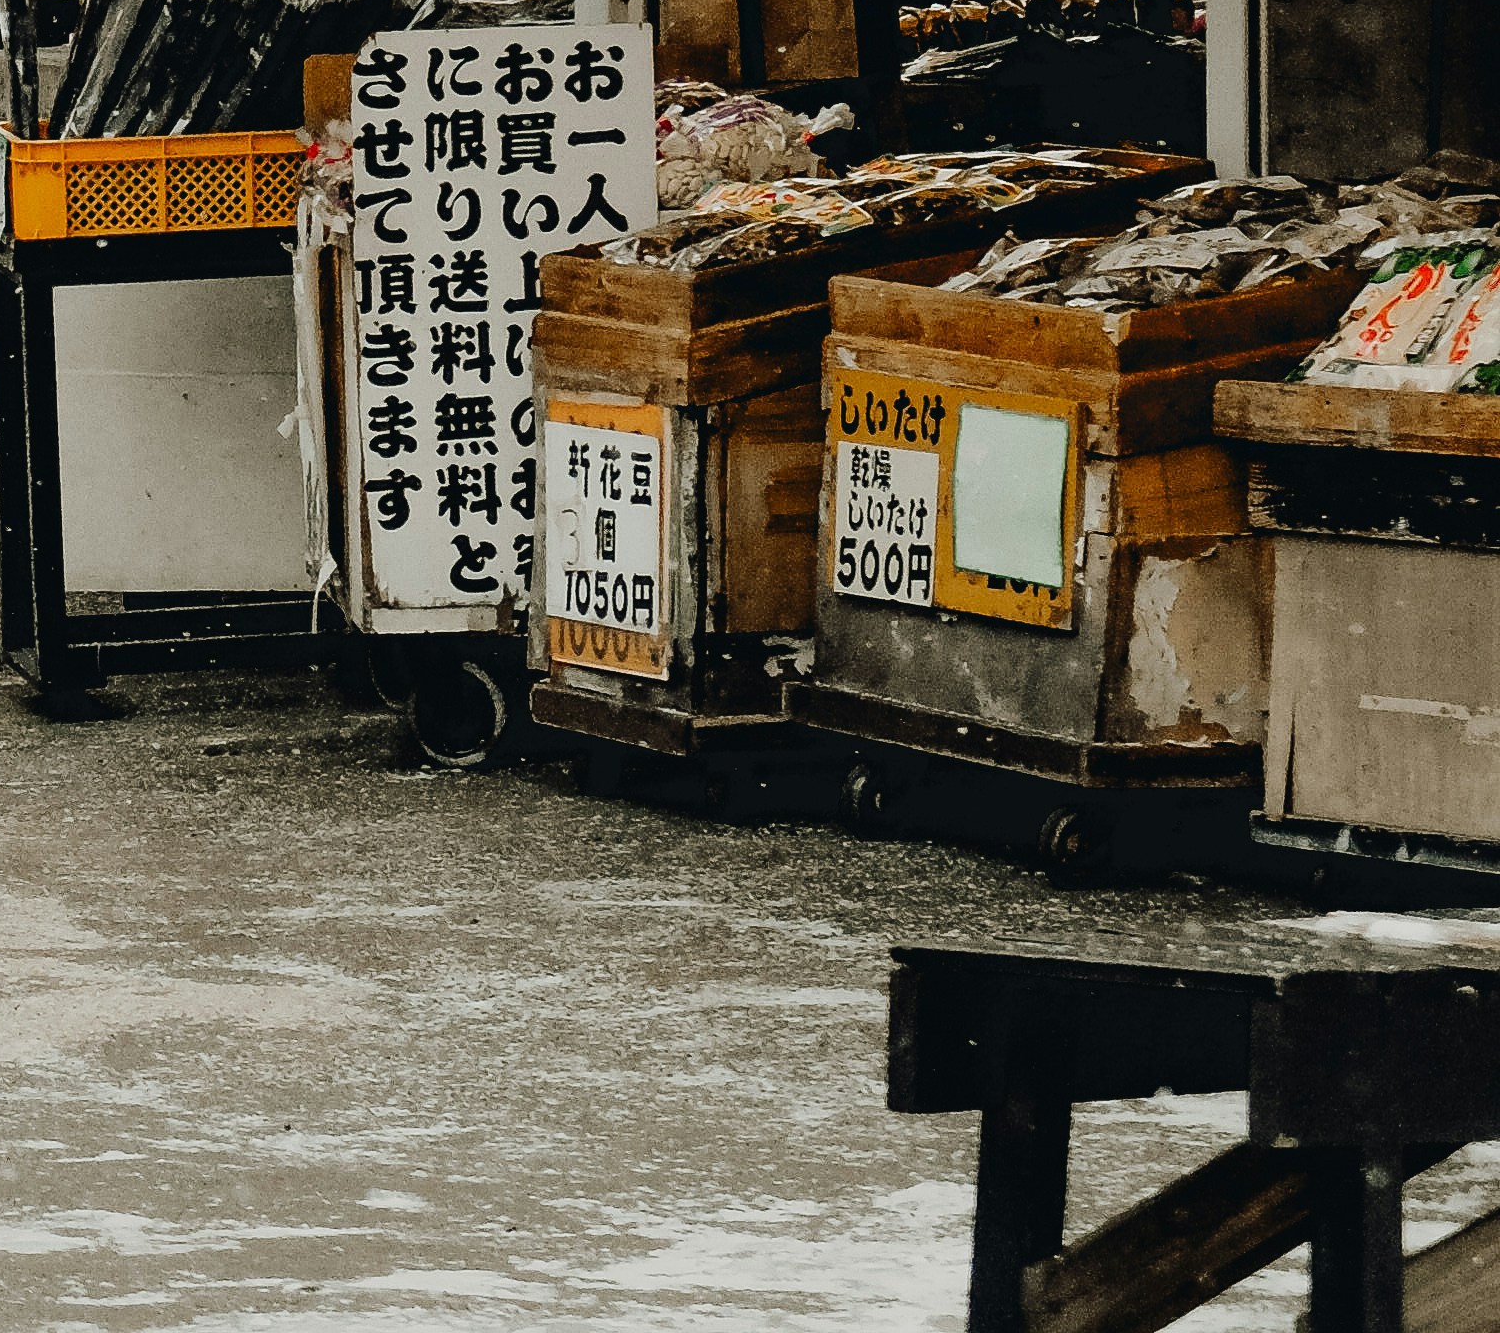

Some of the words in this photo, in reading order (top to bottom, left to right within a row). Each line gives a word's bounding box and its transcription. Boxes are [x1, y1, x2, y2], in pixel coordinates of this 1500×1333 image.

[564, 40, 629, 235] お一人
[353, 47, 423, 531] させて頂きます
[424, 45, 502, 593] に限り送料無料と
[841, 384, 946, 446] しいたけ
[848, 491, 928, 539] しいたけ
[565, 570, 655, 629] 1050円
[837, 535, 932, 601] 500円
